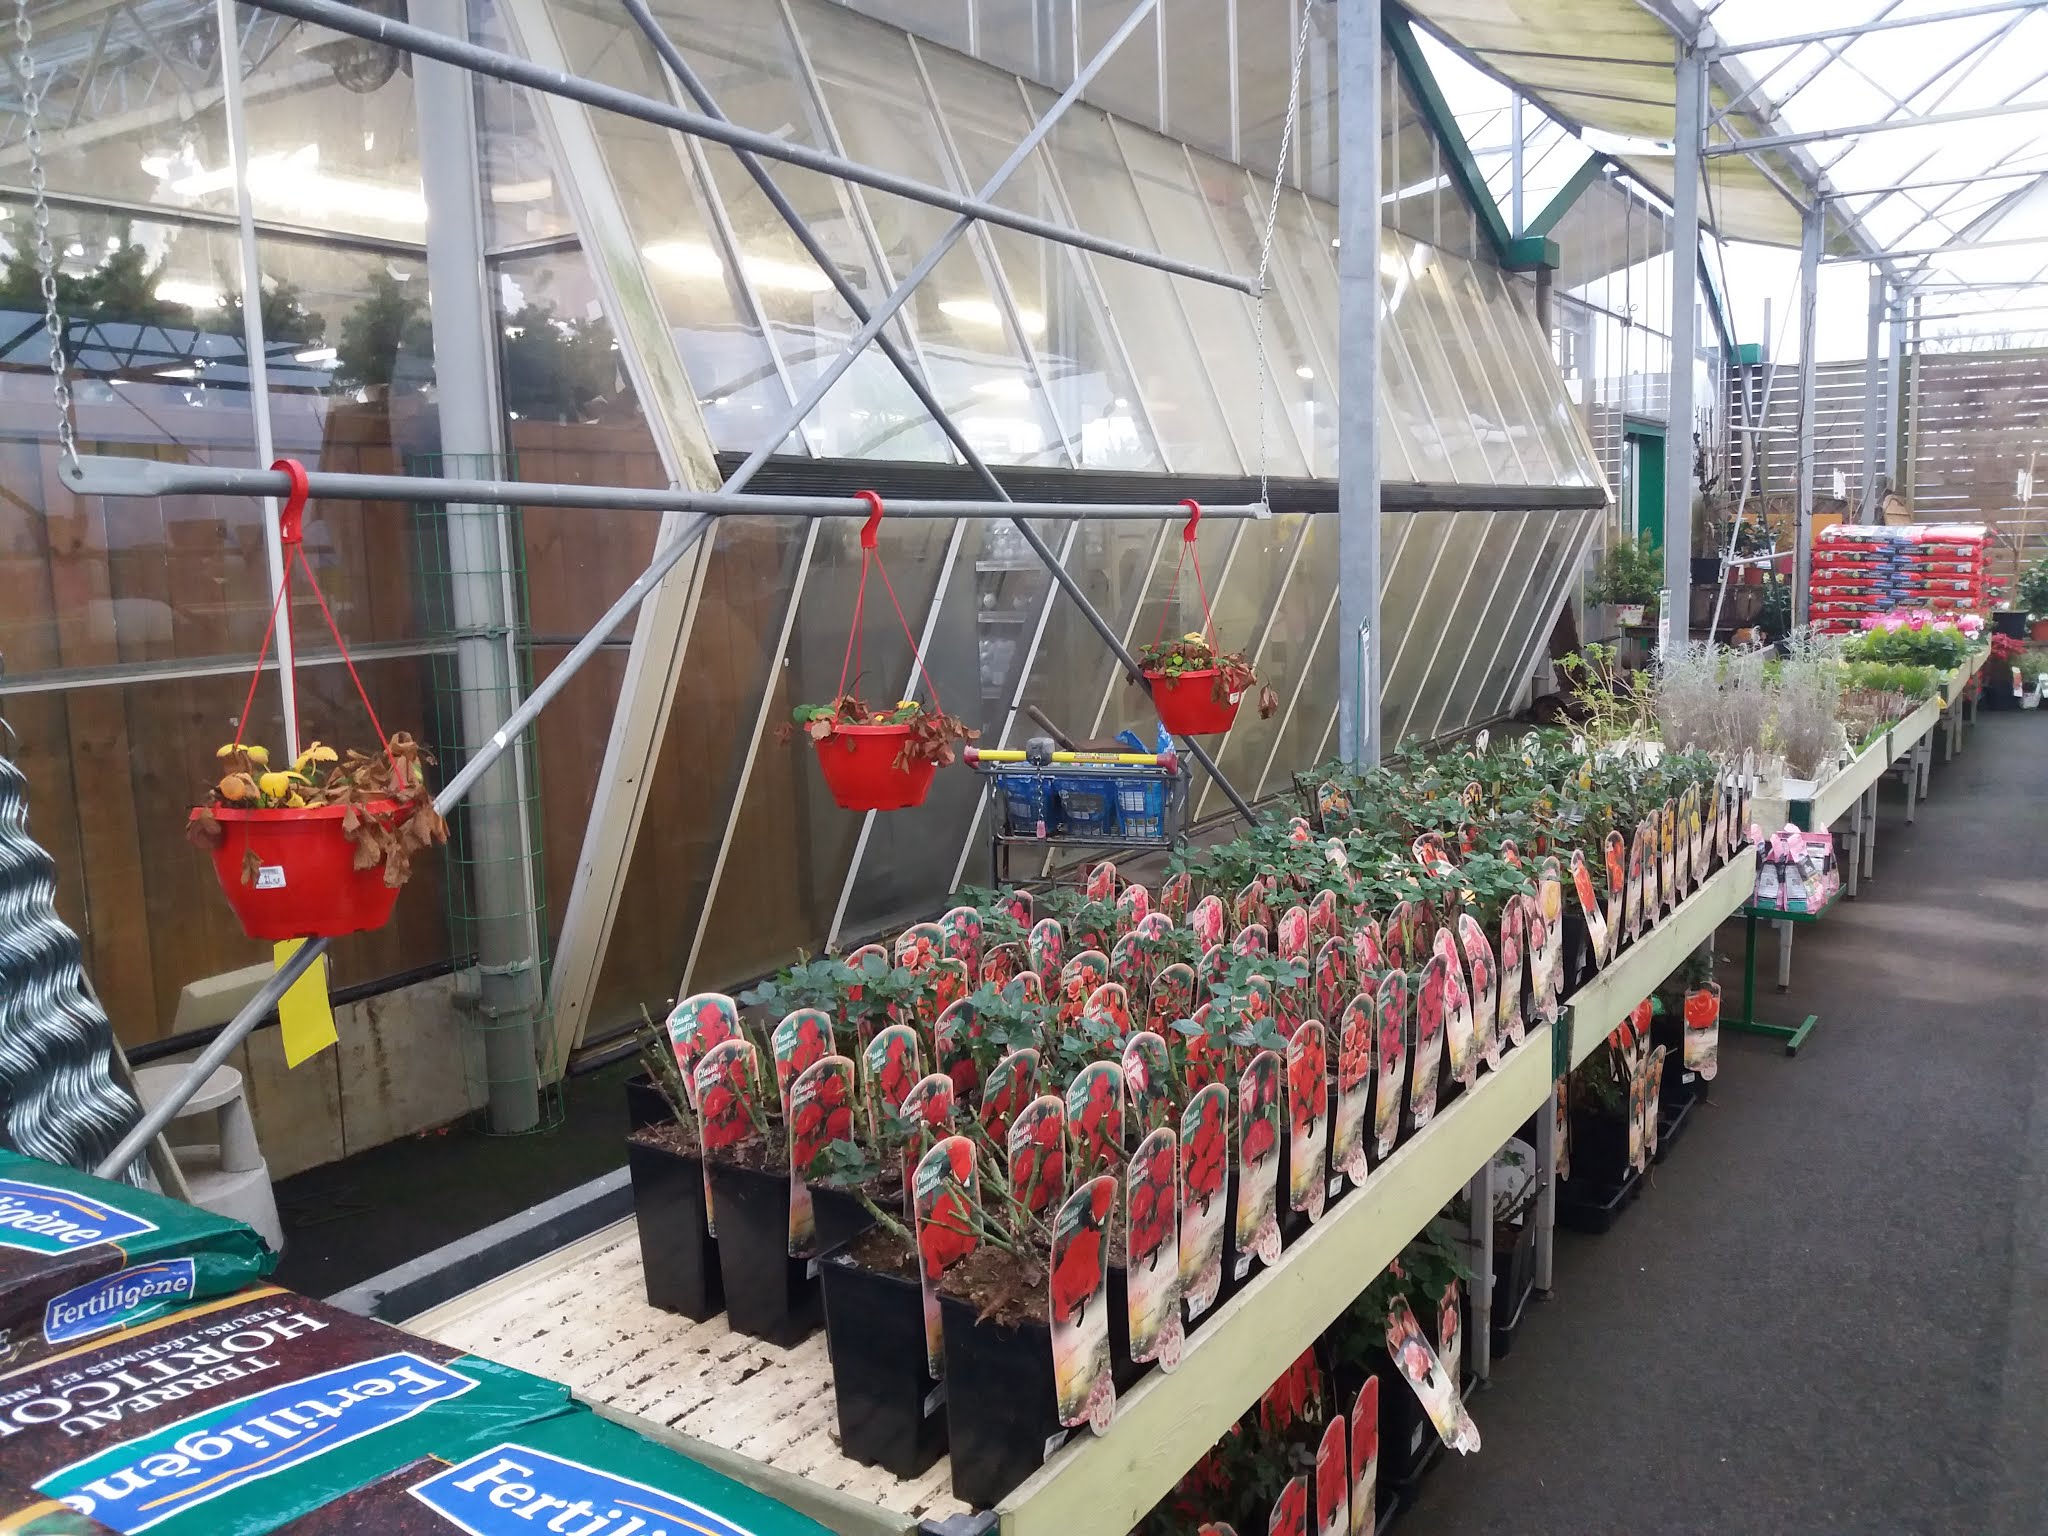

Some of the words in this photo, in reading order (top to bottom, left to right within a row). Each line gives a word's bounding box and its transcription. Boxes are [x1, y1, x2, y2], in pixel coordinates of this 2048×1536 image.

[670, 1013, 693, 1028] Classic
[698, 1063, 719, 1080] Classic
[917, 1162, 943, 1186] Classic
[916, 1176, 941, 1199] beauties
[51, 1277, 188, 1330] Fertiligène
[85, 1330, 200, 1376] LÉGUMES
[50, 1372, 86, 1389] ET
[60, 1356, 280, 1436] TERREAU
